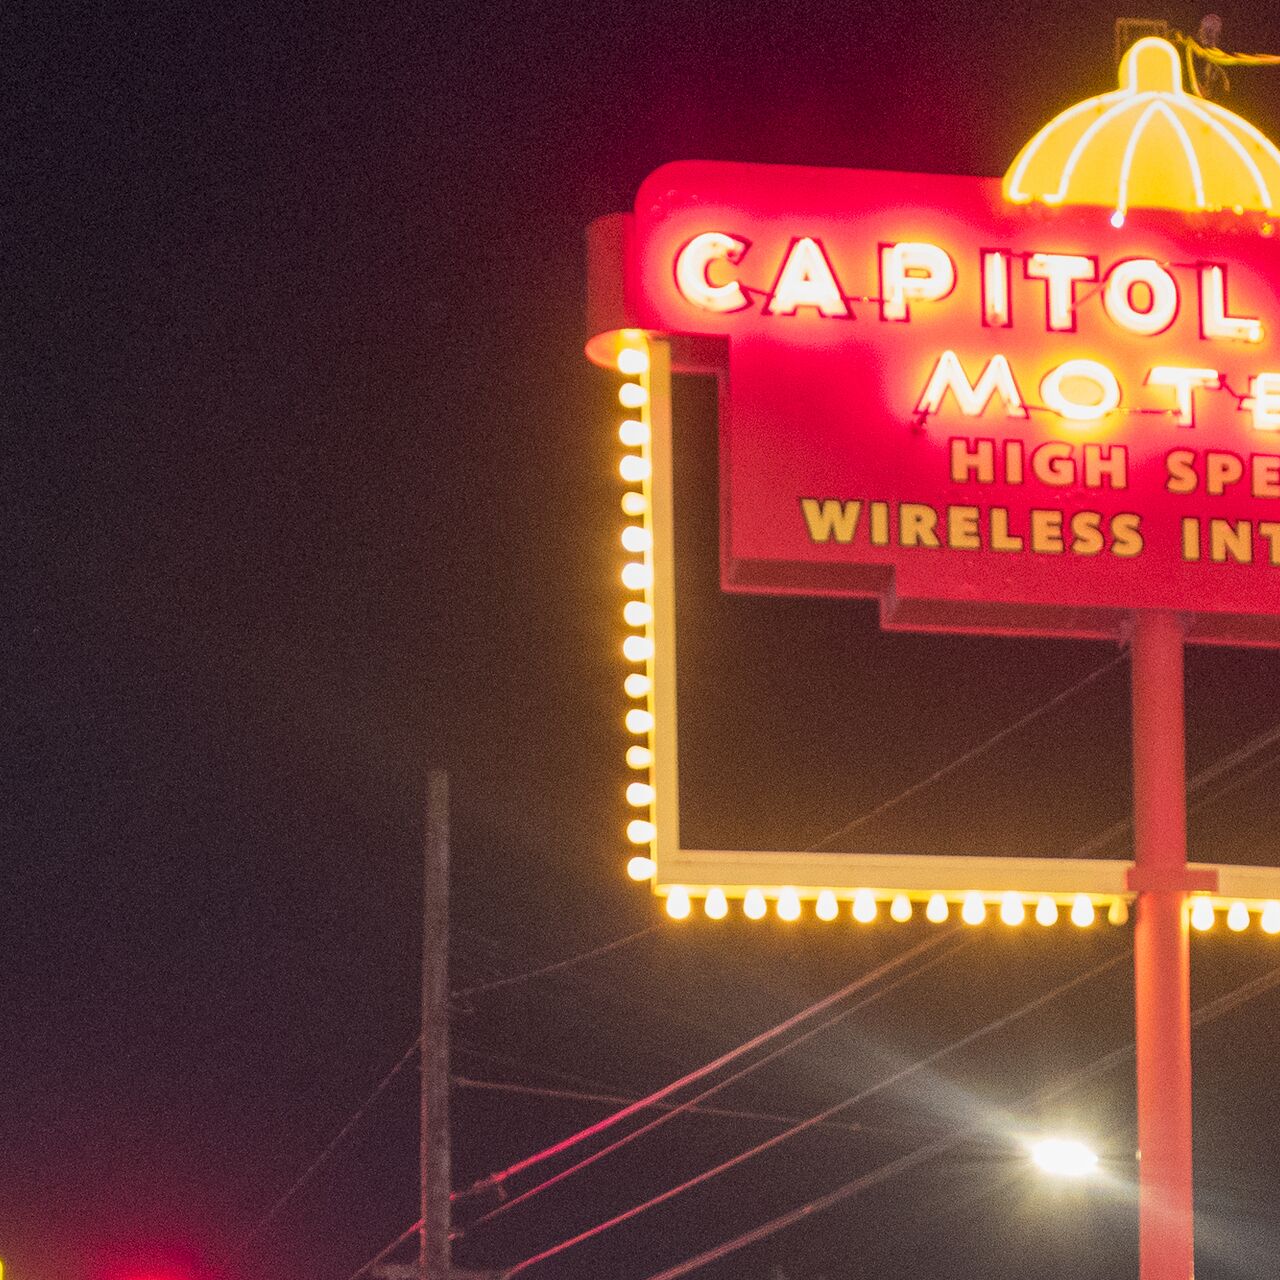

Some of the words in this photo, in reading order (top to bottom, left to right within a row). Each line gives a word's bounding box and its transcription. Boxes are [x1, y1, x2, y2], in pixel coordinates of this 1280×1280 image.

[675, 231, 1264, 341] CAPITOL
[949, 437, 1129, 491] HIGH
[801, 498, 1144, 558] WIRELESS
